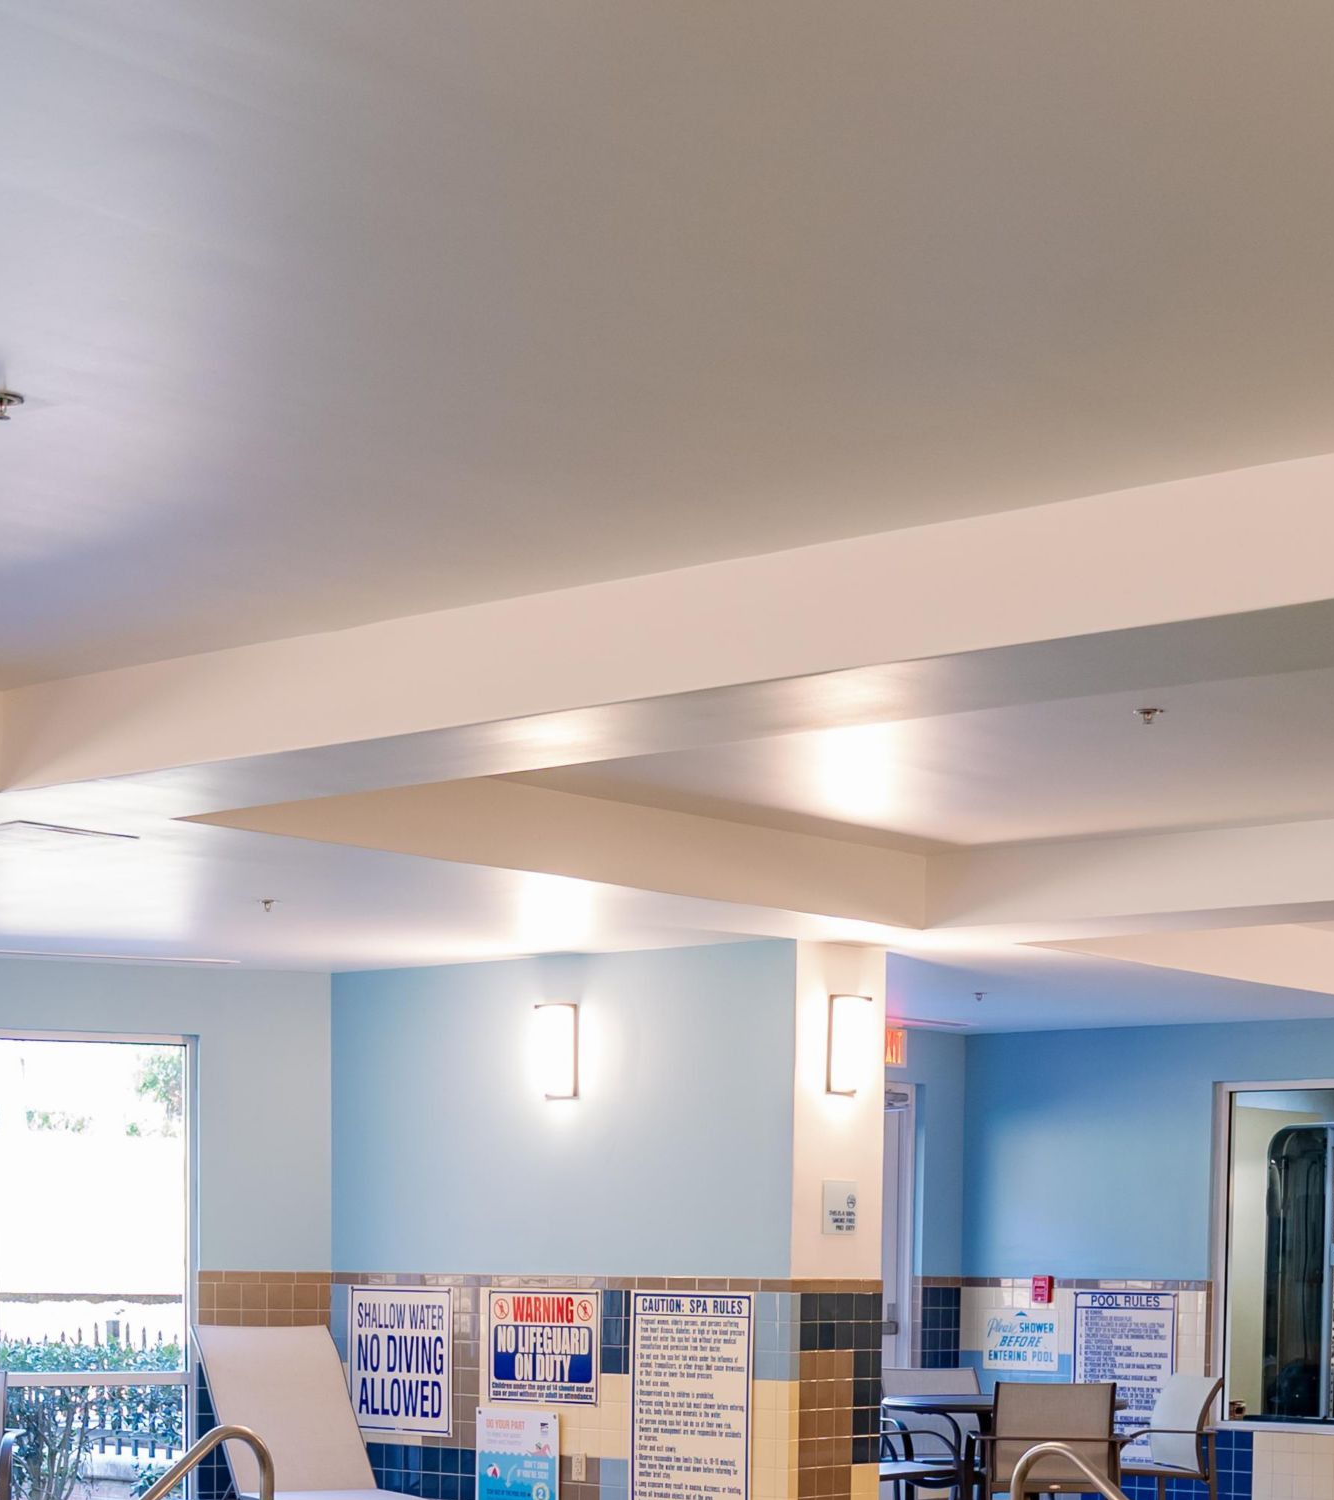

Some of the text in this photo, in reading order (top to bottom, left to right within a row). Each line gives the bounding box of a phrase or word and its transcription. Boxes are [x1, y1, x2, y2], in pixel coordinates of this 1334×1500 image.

[886, 1031, 903, 1064] XIT
[513, 1296, 573, 1323] WARNING
[642, 1298, 743, 1314] CAUTION: SPA RULES
[1091, 1295, 1160, 1307] POOL RULES
[358, 1302, 444, 1330] SHALLOW WATER
[1019, 1323, 1054, 1333] SHOWER
[497, 1326, 589, 1355] NO LIFEGUARD
[999, 1336, 1043, 1347] BEFORE
[358, 1334, 444, 1375] NO DIVING
[515, 1353, 571, 1382] ON DUTY
[989, 1350, 1053, 1362] ENTERING POOL
[359, 1377, 442, 1418] ALLOWED
[537, 1488, 544, 1499] 2
